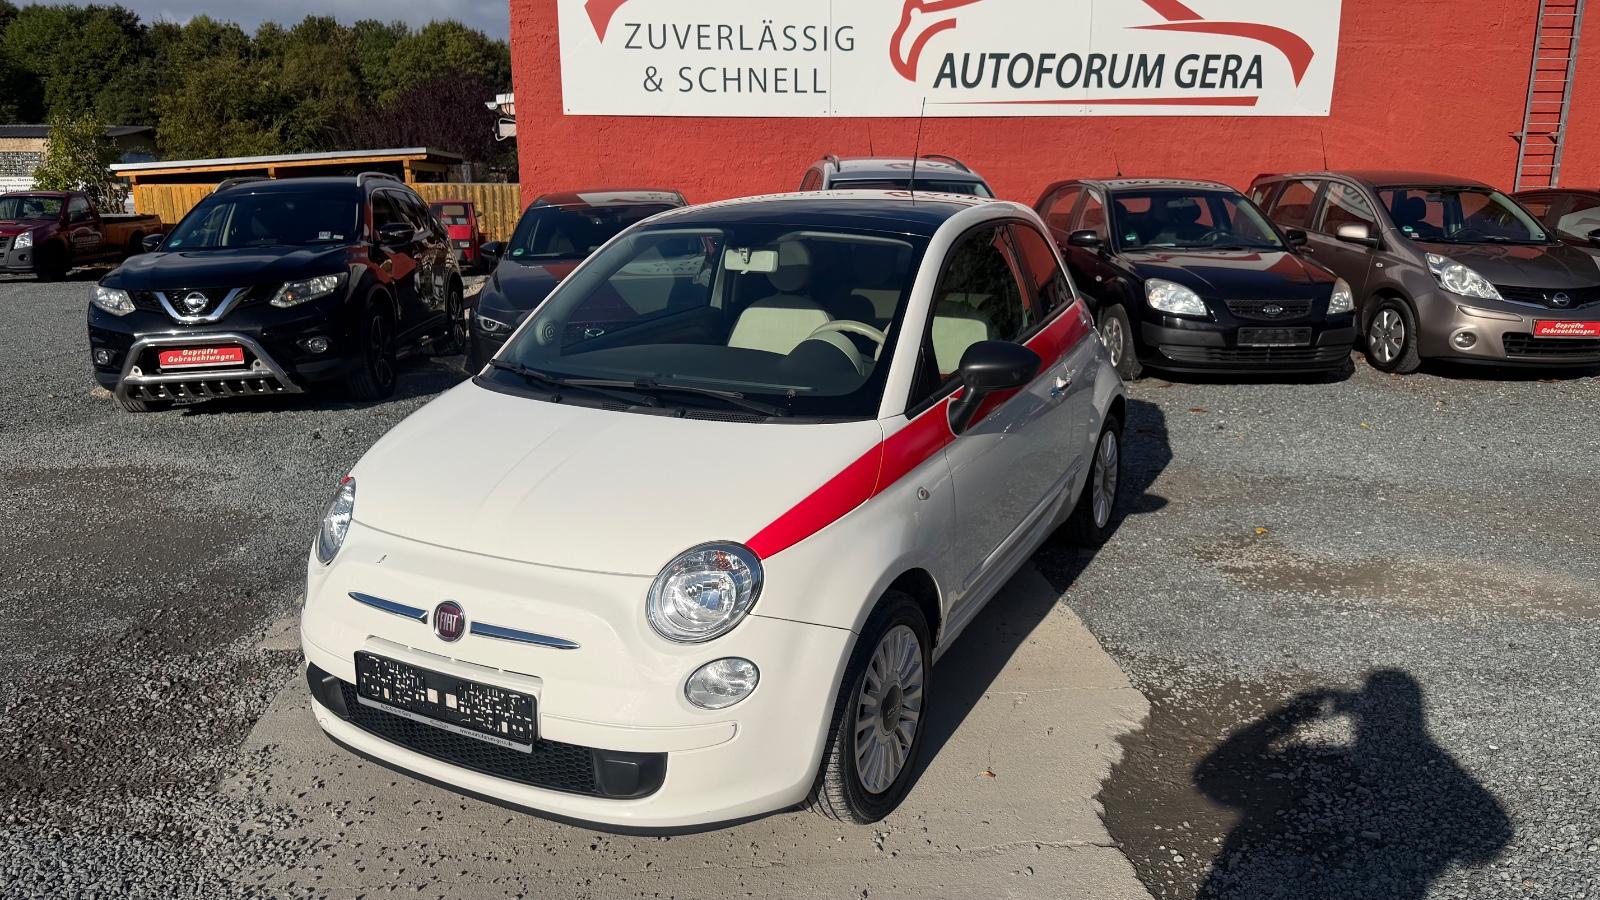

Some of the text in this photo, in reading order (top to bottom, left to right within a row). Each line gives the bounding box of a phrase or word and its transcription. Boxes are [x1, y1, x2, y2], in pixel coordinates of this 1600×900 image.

[624, 19, 855, 52] ZUVERLÄSSIG
[643, 66, 827, 93] & SCHNELL
[932, 52, 1263, 89] AUTOFORUM GERA
[168, 354, 235, 363] Gebrauchtwagen
[182, 348, 218, 356] Geprüfte
[439, 611, 459, 633] FIAT
